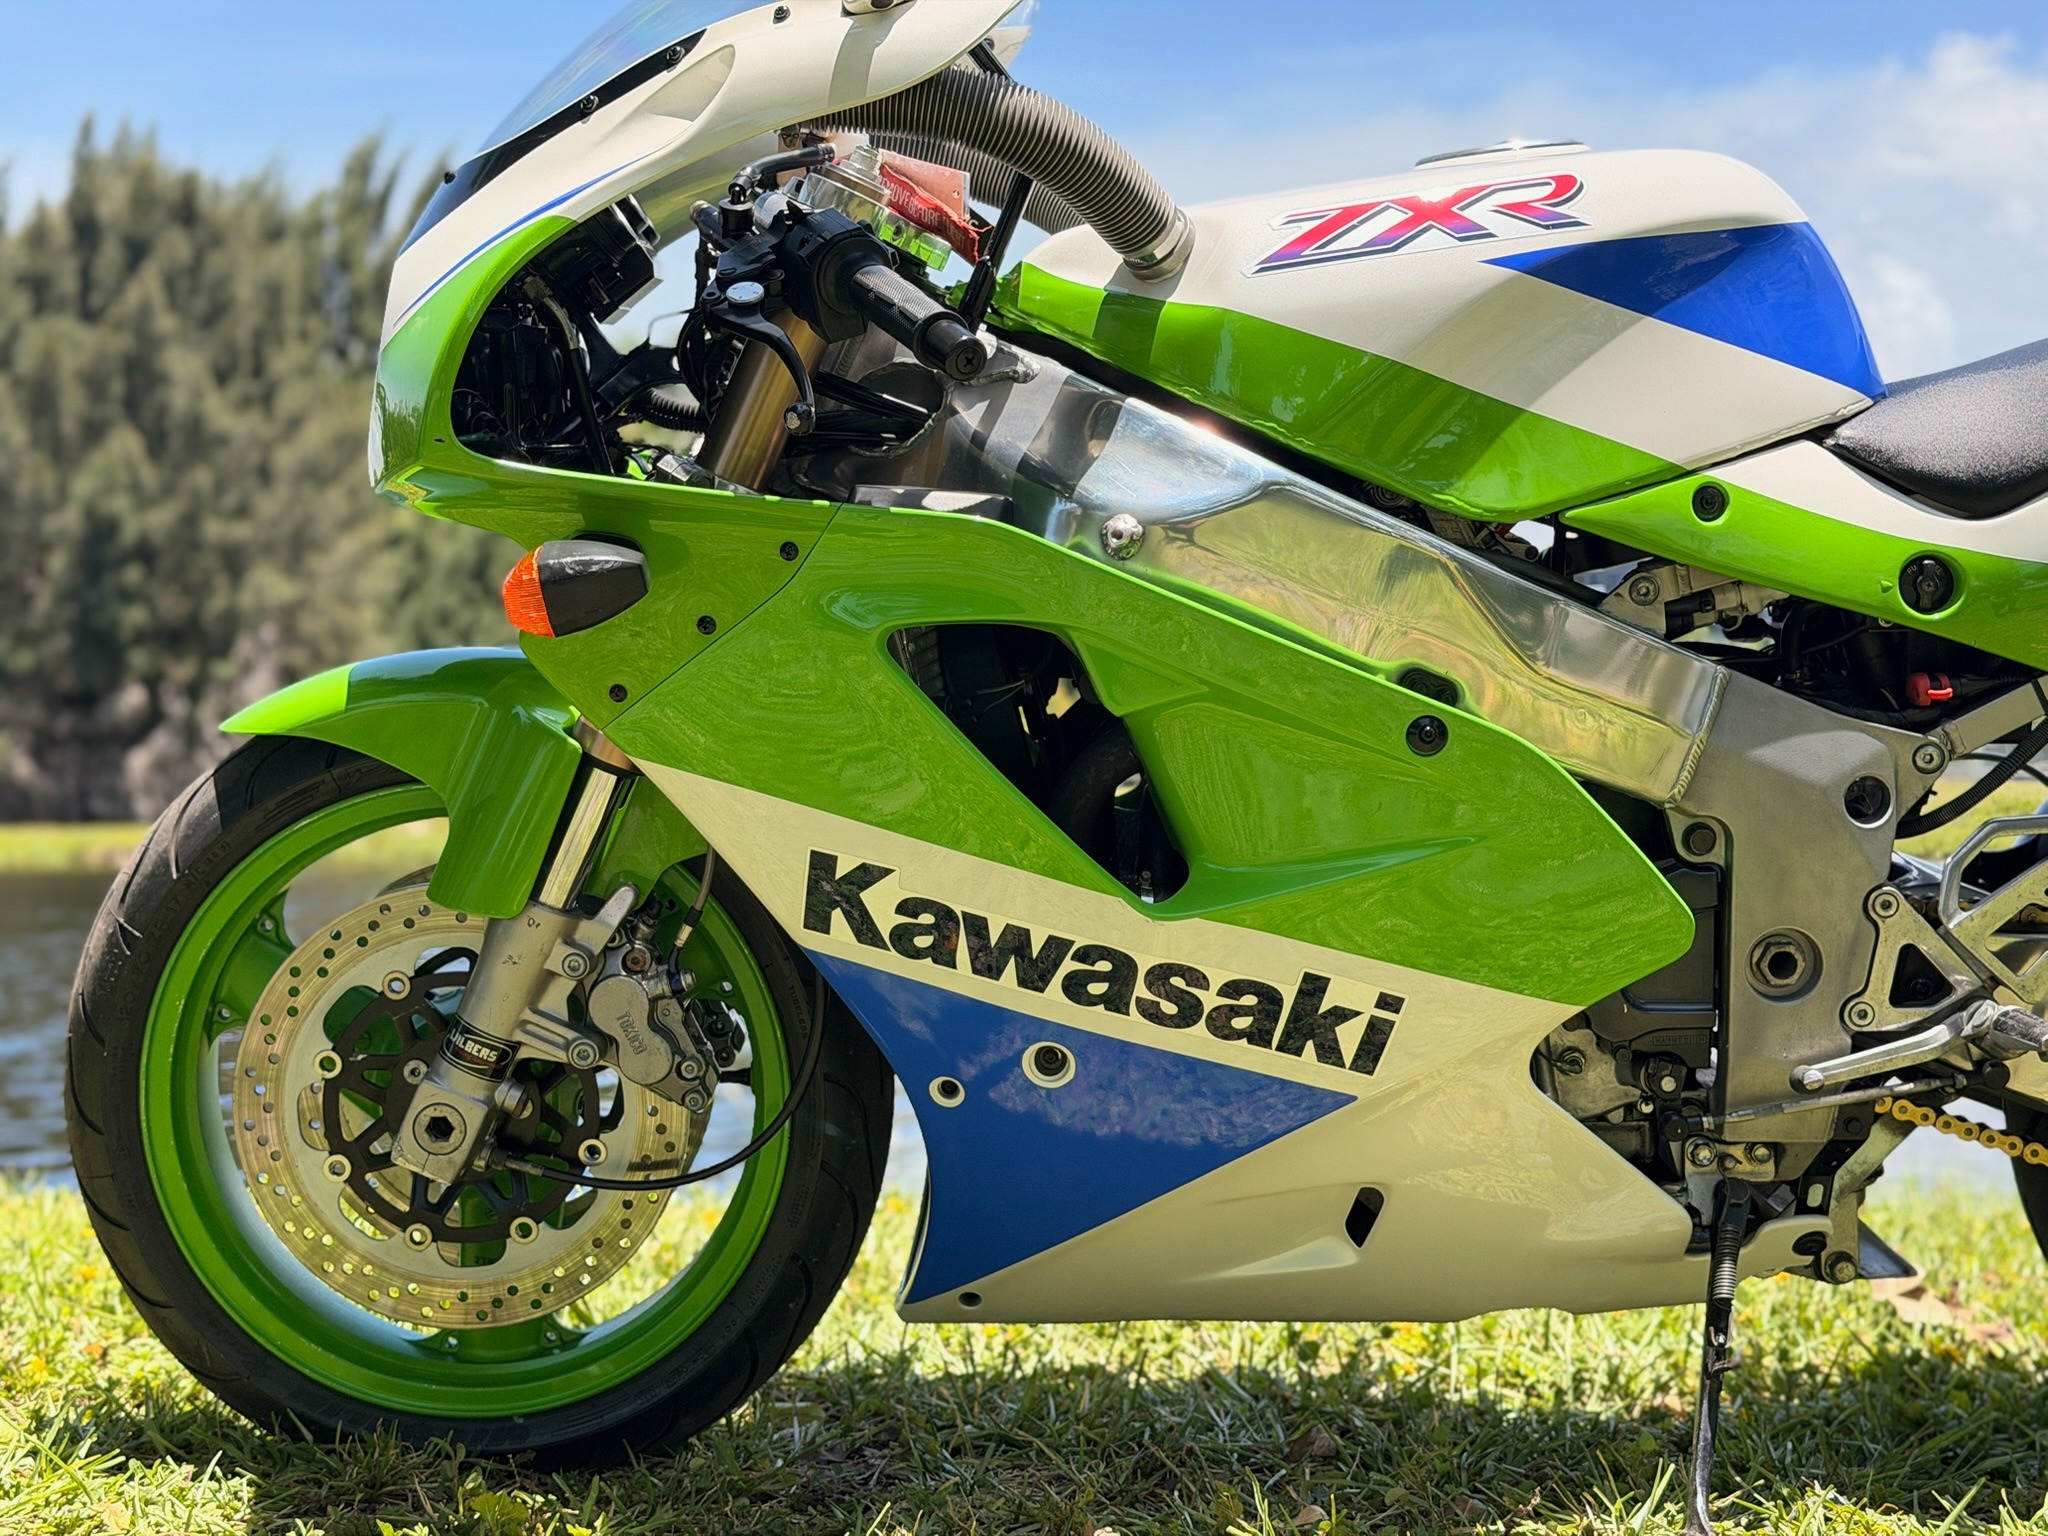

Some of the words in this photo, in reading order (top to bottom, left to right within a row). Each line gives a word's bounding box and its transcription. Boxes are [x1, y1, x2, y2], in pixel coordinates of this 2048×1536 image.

[1250, 174, 1592, 275] ZXR
[803, 849, 1406, 1078] Kawasaki
[617, 1010, 648, 1056] TOKICO
